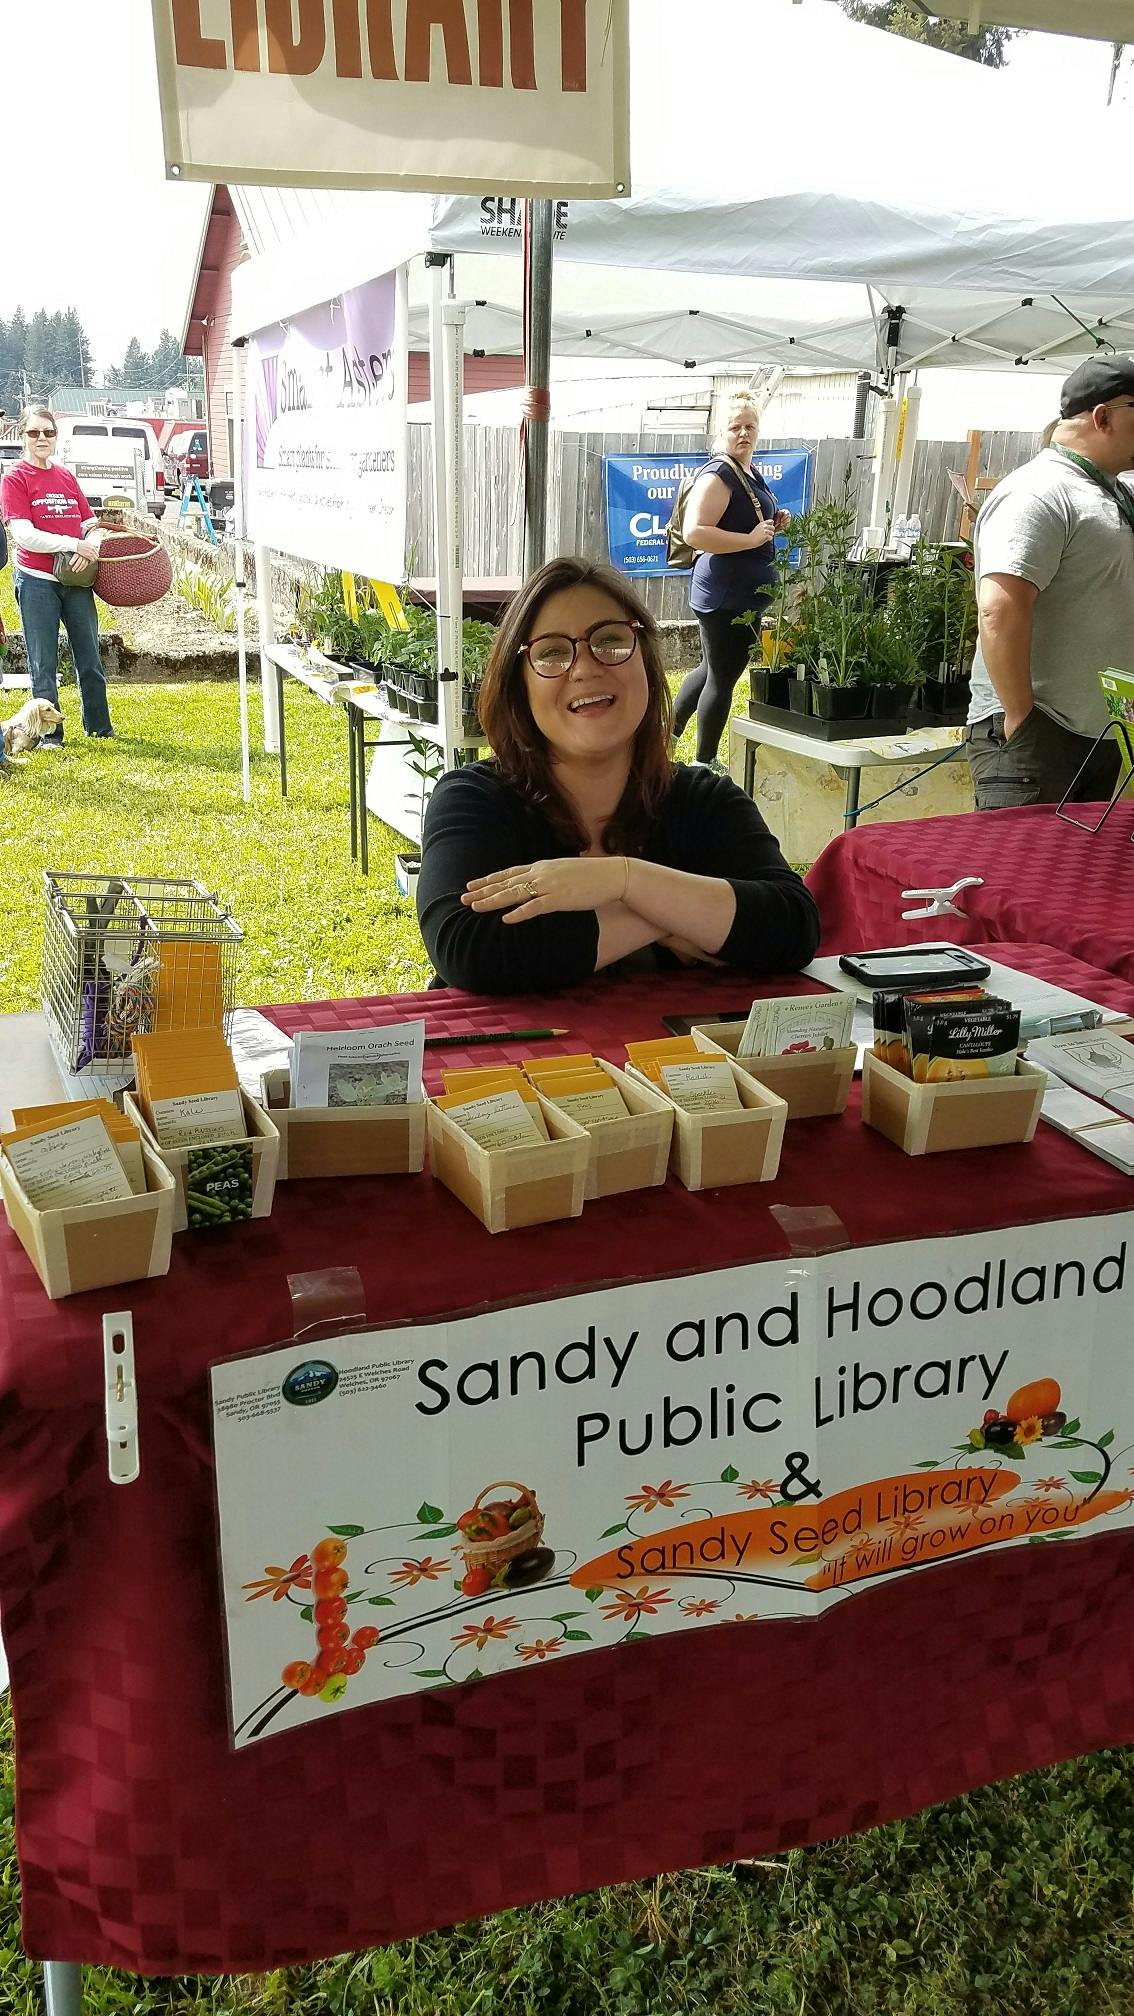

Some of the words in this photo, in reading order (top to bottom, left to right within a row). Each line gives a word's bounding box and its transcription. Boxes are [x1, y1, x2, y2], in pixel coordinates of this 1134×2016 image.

[631, 463, 692, 481] Proudly
[647, 486, 676, 500] our
[815, 1000, 839, 1009] Garden
[949, 1026, 971, 1041] Lilly
[971, 1025, 1003, 1037] Miller
[326, 1043, 366, 1052] Heirloom
[368, 1041, 393, 1051] Orach
[394, 1037, 415, 1048] Seed
[206, 1180, 239, 1192] PEAS
[416, 1326, 639, 1416] Sandy
[666, 1292, 800, 1362] and
[827, 1241, 1128, 1339] Hoodland
[338, 1366, 369, 1375] Hoodland
[371, 1361, 391, 1369] Public
[392, 1358, 414, 1367] Library
[363, 1368, 392, 1377] Welches
[294, 1379, 326, 1392] SANDY
[380, 1374, 401, 1383] 97067
[214, 1397, 235, 1406] Sandy
[236, 1392, 257, 1400] Public
[257, 1385, 281, 1395] Library
[239, 1397, 266, 1407] Proctor
[266, 1392, 281, 1400] Blvd
[338, 1387, 357, 1397] (503)
[225, 1408, 249, 1418] Sandy,
[577, 1385, 782, 1468] Public
[814, 1349, 1010, 1429] Library
[779, 1451, 823, 1501] &
[616, 1526, 752, 1580] Sandy
[768, 1497, 863, 1555] Seed
[876, 1472, 998, 1523] Library
[855, 1537, 893, 1570] will
[901, 1522, 970, 1562] grow
[979, 1513, 1014, 1535] on
